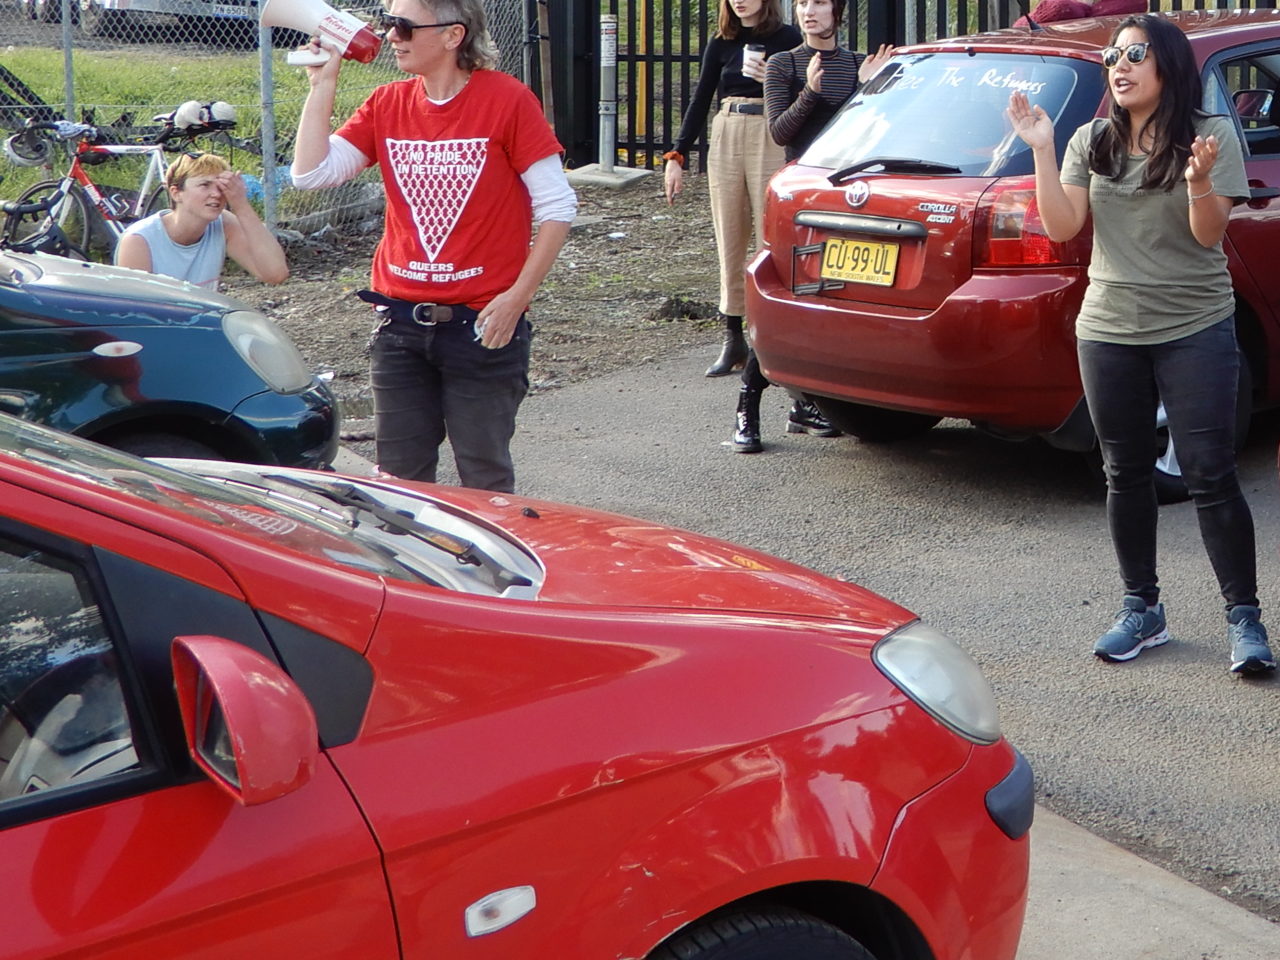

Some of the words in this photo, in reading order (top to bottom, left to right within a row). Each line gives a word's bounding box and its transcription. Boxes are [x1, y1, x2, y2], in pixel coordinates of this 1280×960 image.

[937, 66, 966, 88] The
[409, 151, 424, 162] NO
[427, 151, 463, 162] PRIDE
[397, 163, 409, 174] IN
[411, 163, 477, 175] DETENTION
[919, 202, 957, 214] COROLLA
[926, 214, 955, 224] ASCENT
[408, 260, 454, 272] QUEERS
[389, 263, 428, 282] WELCOME
[431, 266, 484, 282] REFUGEES
[829, 270, 842, 279] NEW
[844, 271, 864, 281] SOUTH
[865, 273, 885, 284] WALES
